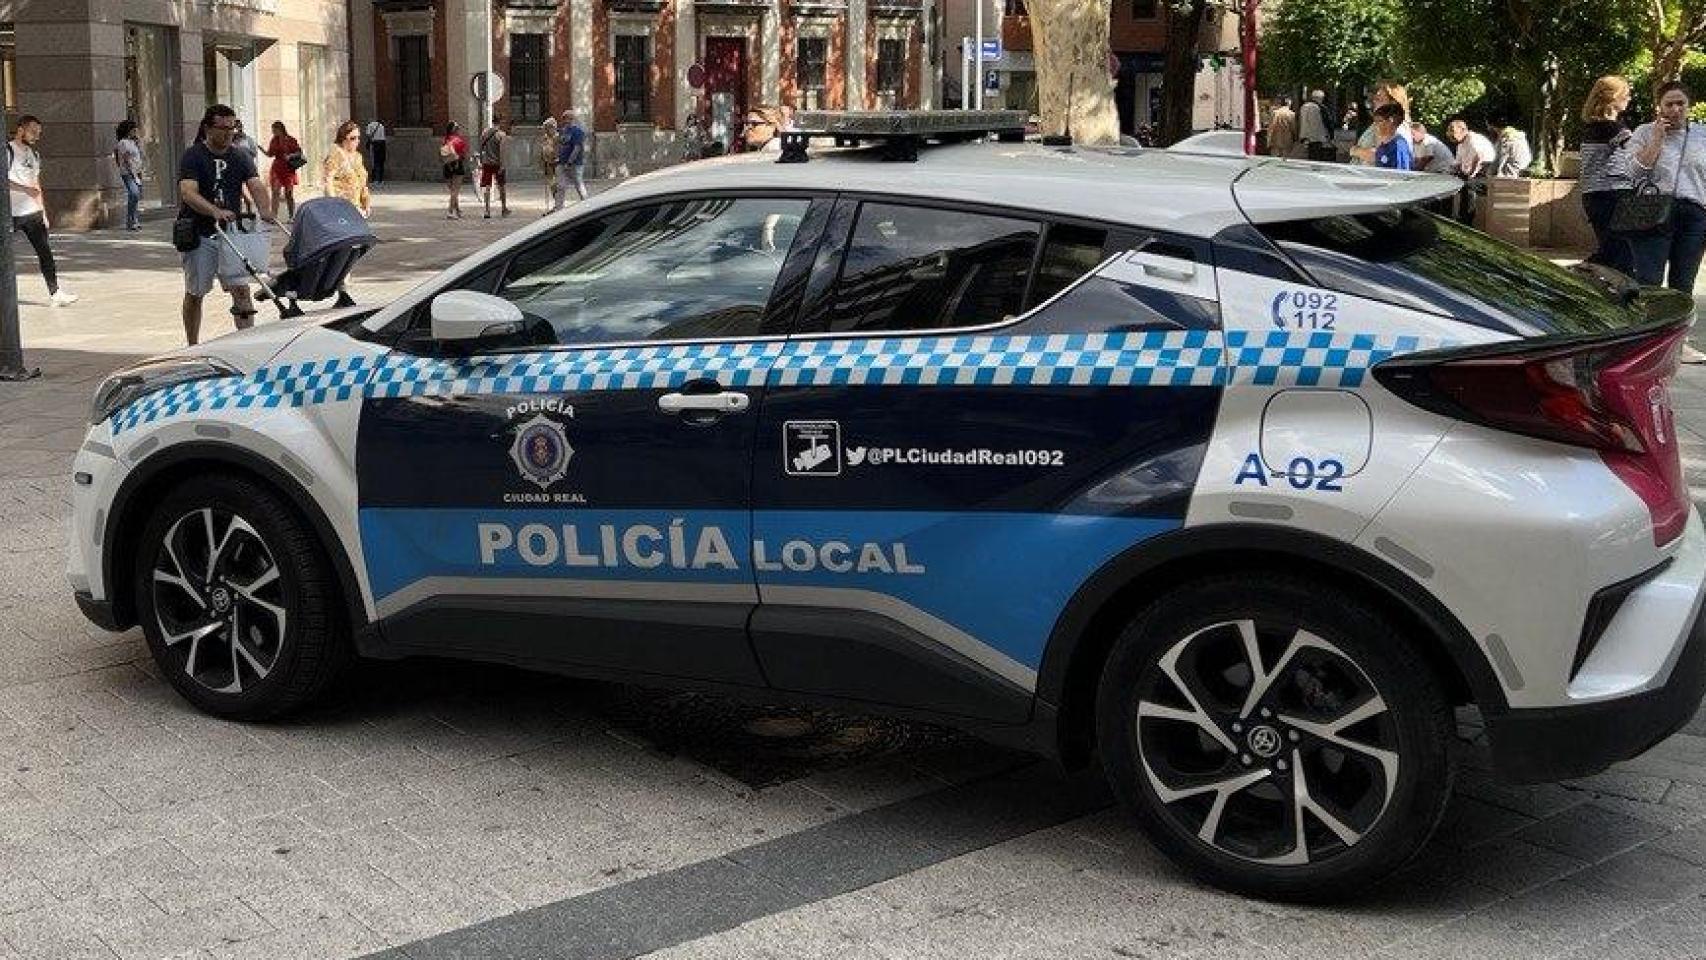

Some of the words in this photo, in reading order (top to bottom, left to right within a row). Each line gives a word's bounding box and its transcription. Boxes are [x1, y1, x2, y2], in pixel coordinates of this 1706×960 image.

[1293, 292, 1337, 311] 092
[1294, 312, 1335, 330] 112
[505, 398, 574, 419] POLICÍA
[867, 448, 1064, 467] @PLCiudadReal092
[1235, 453, 1343, 492] A-02
[503, 493, 549, 503] CIUDAD
[553, 493, 587, 503] REAL
[478, 518, 739, 570] POLICÍA
[753, 539, 926, 574] LOCAL
